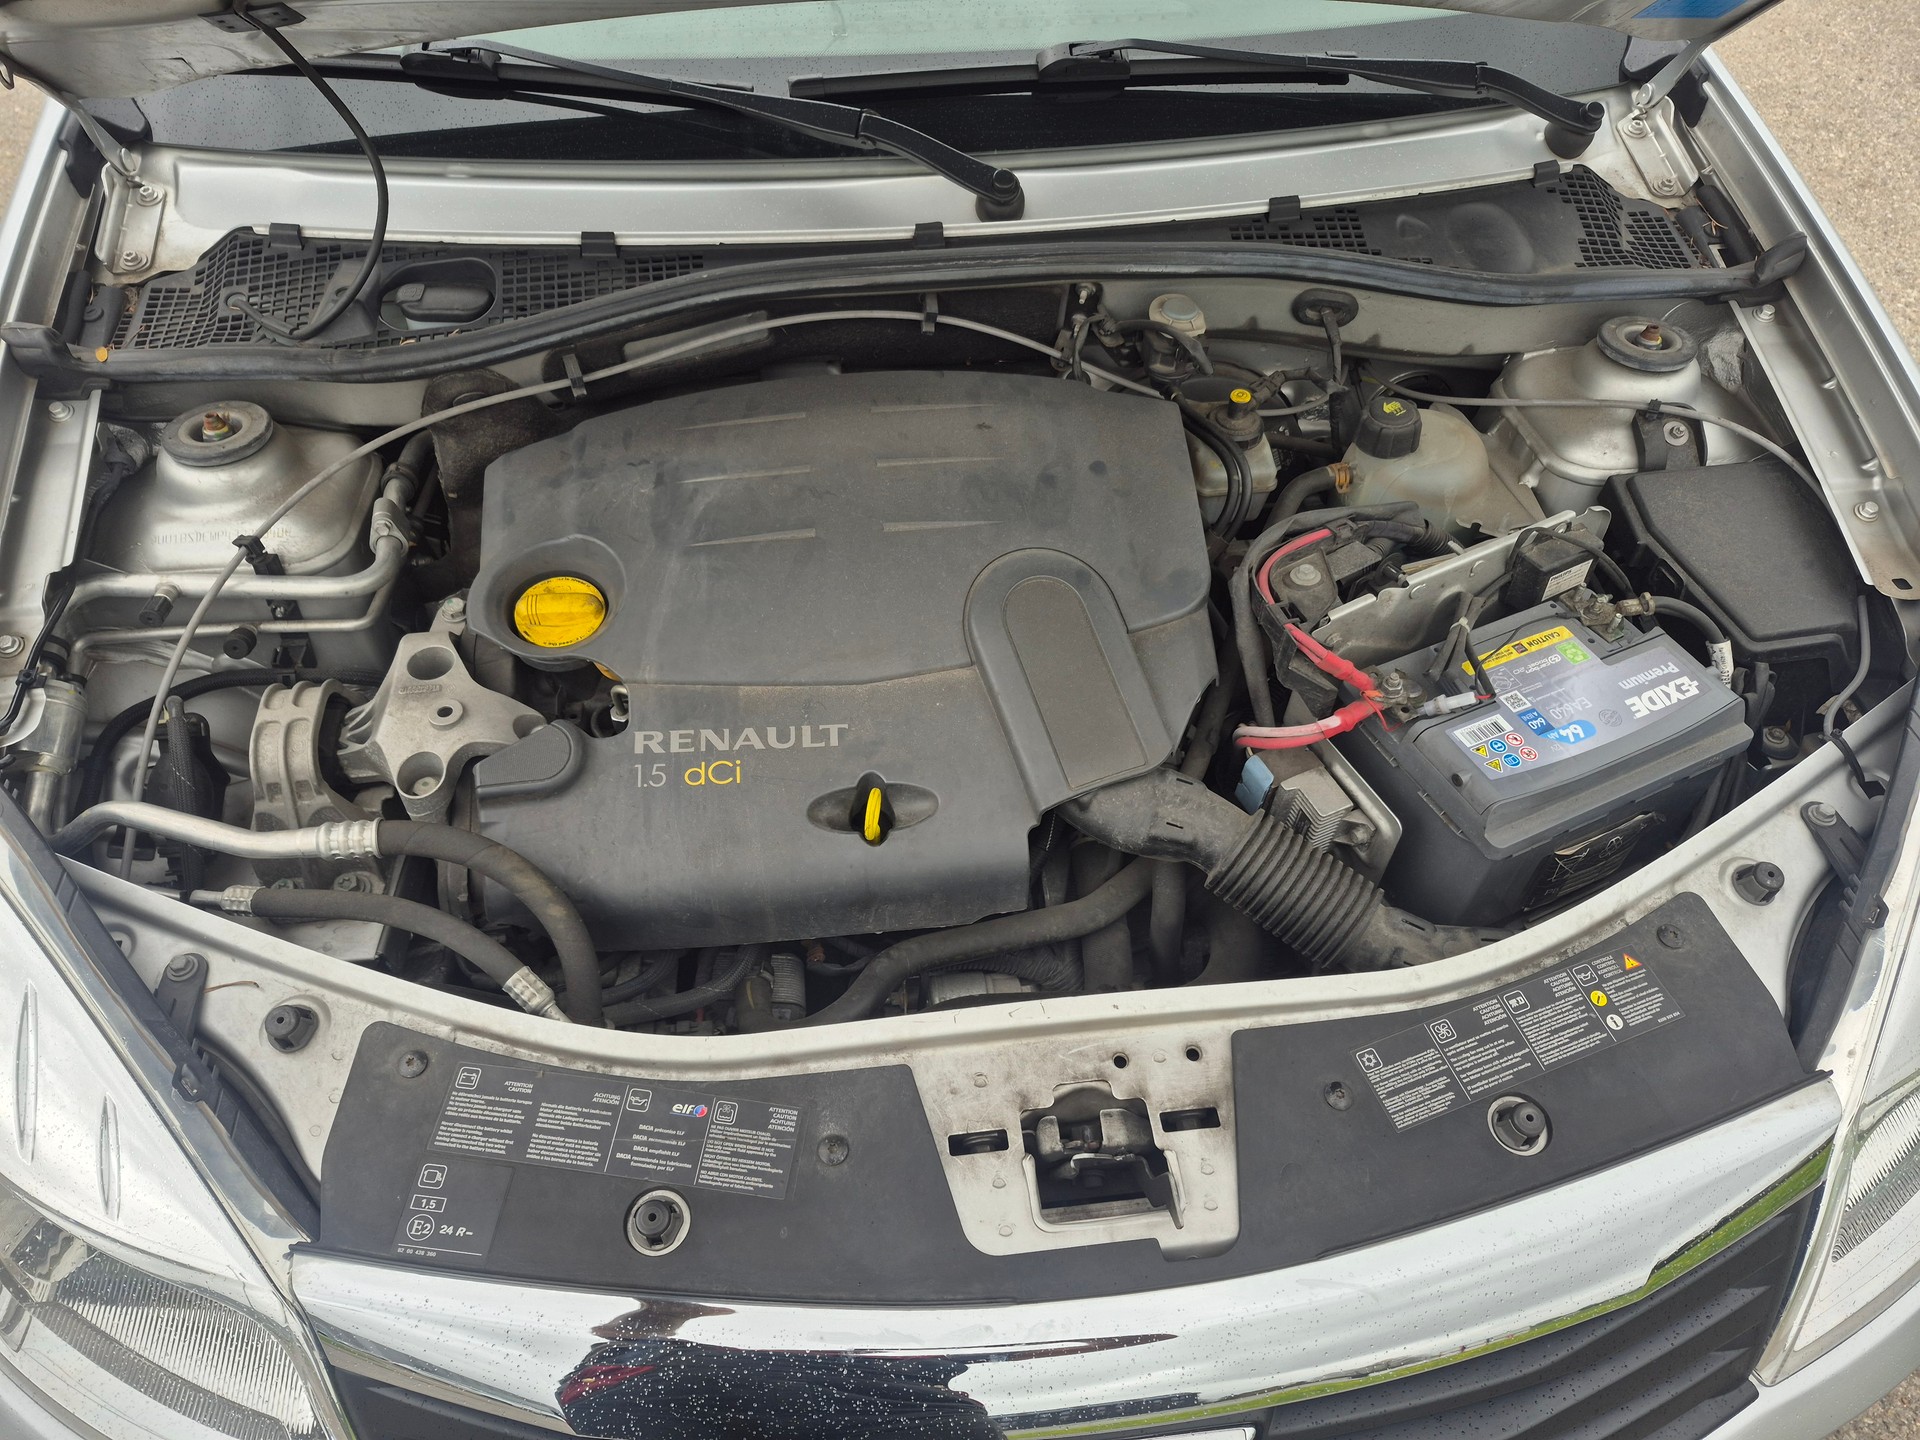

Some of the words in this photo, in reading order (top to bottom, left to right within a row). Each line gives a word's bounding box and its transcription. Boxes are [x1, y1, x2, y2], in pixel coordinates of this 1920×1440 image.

[1526, 631, 1561, 648] CAUTION
[1618, 661, 1680, 690] Premium
[1624, 675, 1699, 720] EXIDE
[1528, 717, 1547, 730] 640
[633, 723, 849, 754] RENAULT
[1560, 724, 1585, 742] 64
[634, 763, 667, 788] 1.5
[684, 759, 741, 786] dCi
[1543, 972, 1568, 984] ATTENTION
[1550, 976, 1570, 987] CAUTION
[1472, 998, 1498, 1012] ATTENTION
[1479, 1003, 1501, 1015] CAUTION
[504, 1080, 534, 1089] ATTENTION
[507, 1086, 532, 1094] CAUTION
[594, 1091, 621, 1101] ACHTUNG
[672, 1103, 695, 1115] elf
[768, 1106, 798, 1115] ATTENTION
[769, 1118, 796, 1127] ACHTUNG
[772, 1112, 797, 1121] CAUTION
[421, 1199, 437, 1209] 1,5
[410, 1220, 431, 1235] E2
[439, 1225, 454, 1235] 24
